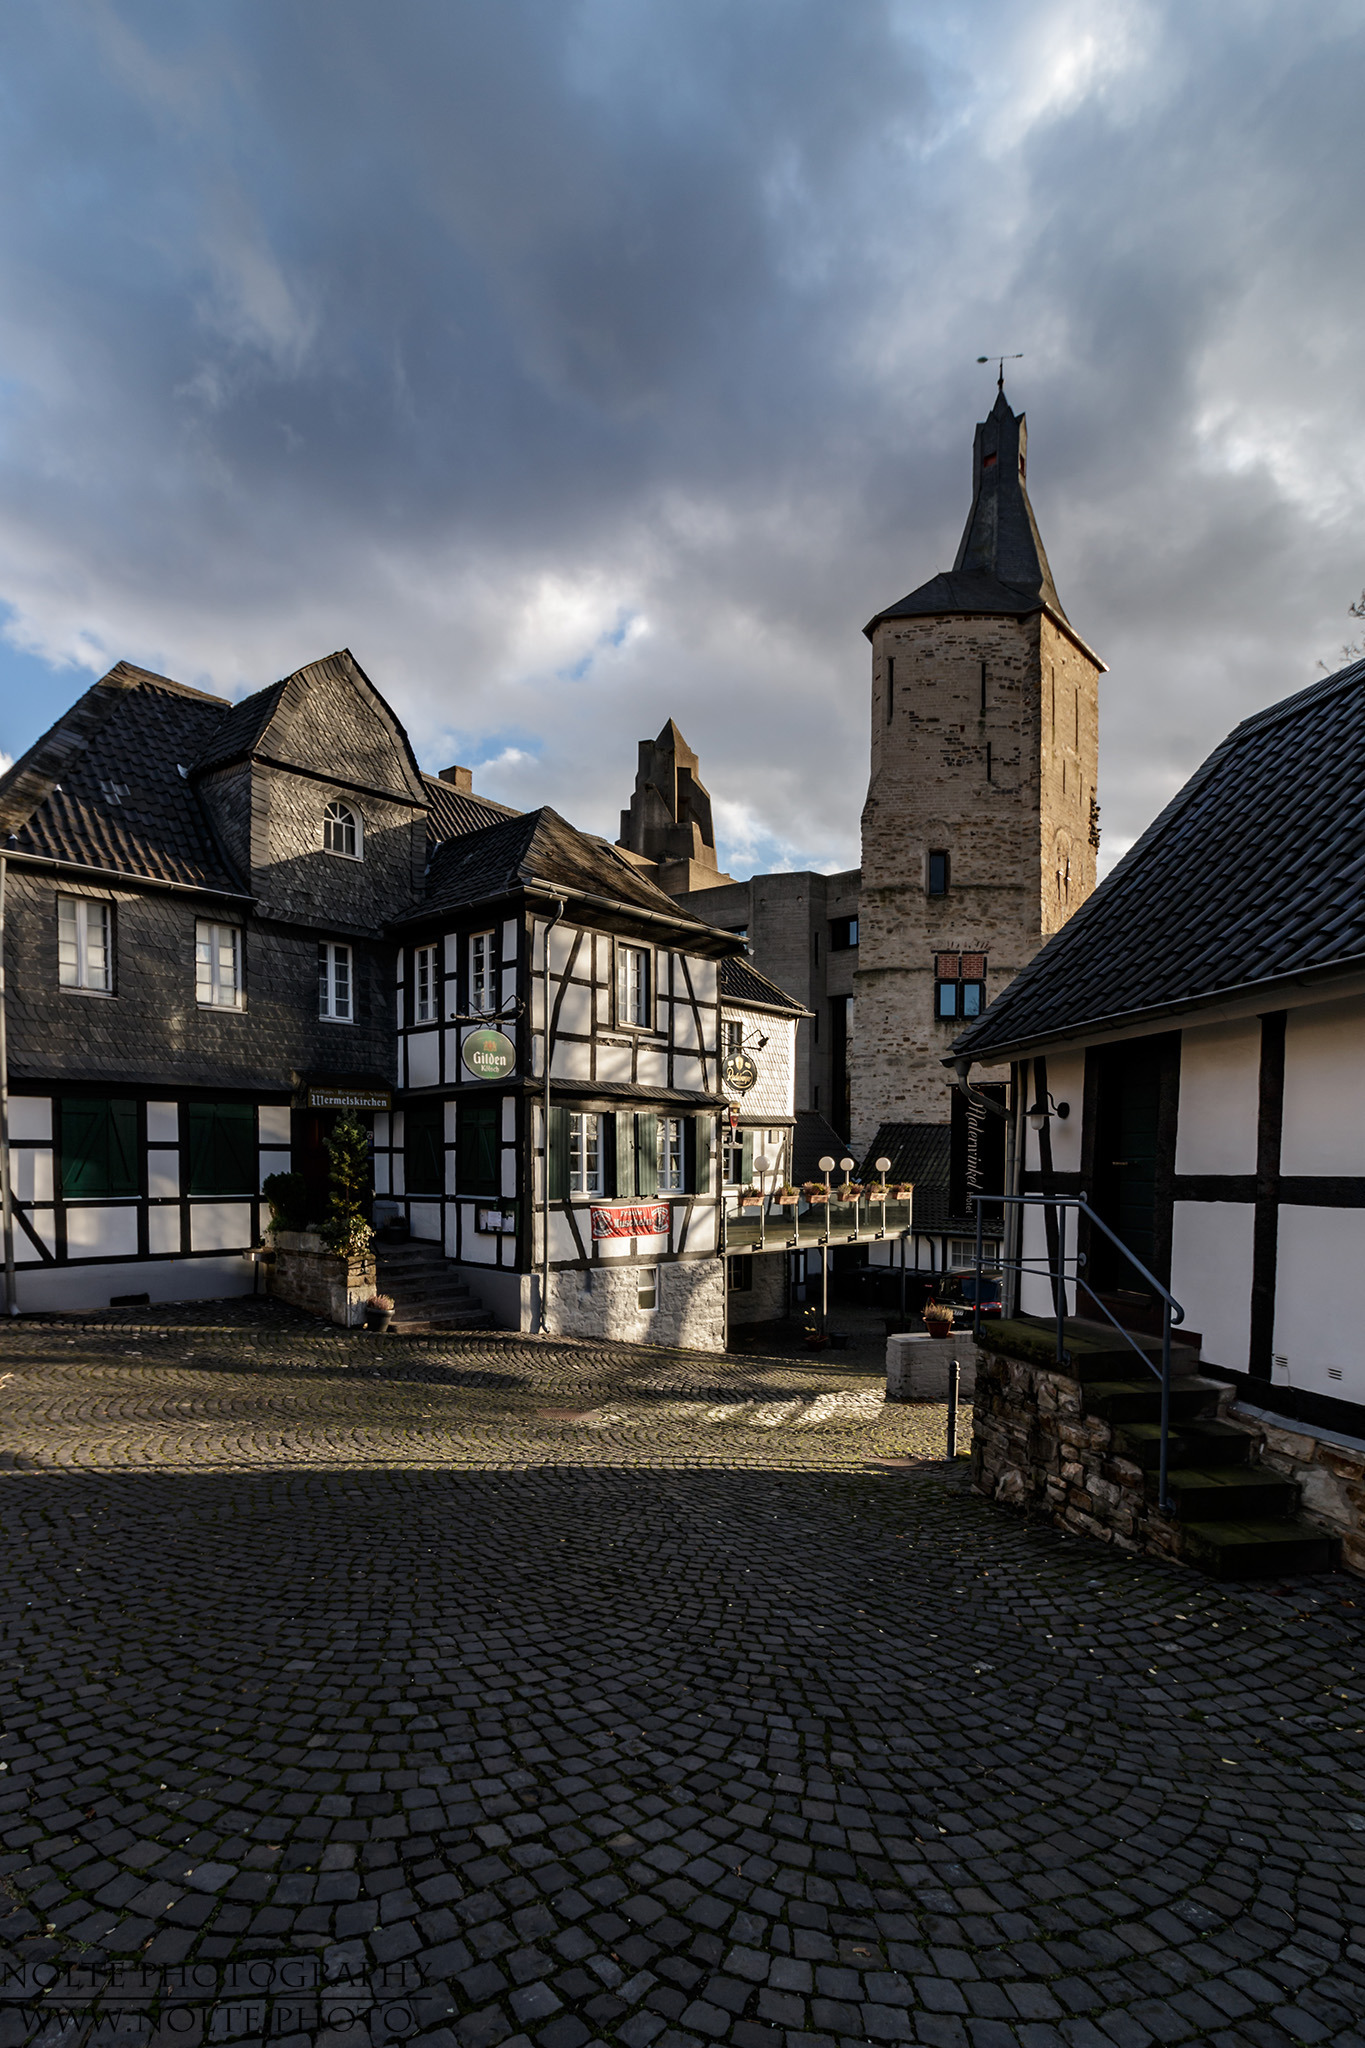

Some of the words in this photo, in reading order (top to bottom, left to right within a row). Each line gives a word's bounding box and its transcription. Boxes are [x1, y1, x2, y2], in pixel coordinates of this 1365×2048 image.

[473, 1051, 507, 1066] Gilden
[311, 1094, 388, 1107] Wermelskirchen
[965, 1097, 987, 1190] Malerwinkel
[965, 1191, 975, 1214] Hotel
